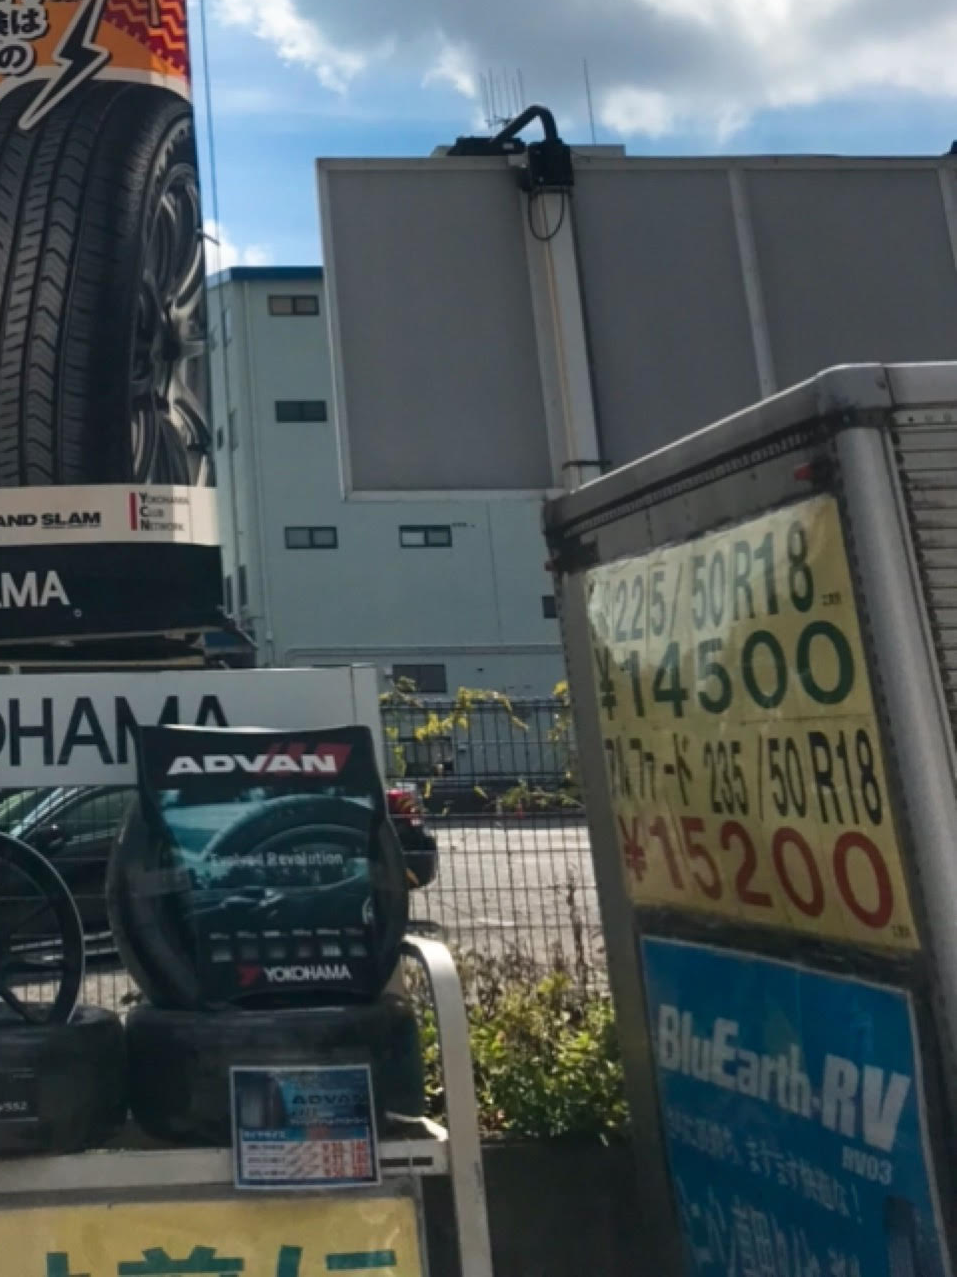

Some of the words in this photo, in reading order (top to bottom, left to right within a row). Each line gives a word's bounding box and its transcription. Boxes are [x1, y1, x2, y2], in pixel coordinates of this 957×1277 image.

[40, 511, 102, 526] SLAM
[166, 754, 338, 775] ADVAN
[263, 963, 353, 983] YOKOHAMA
